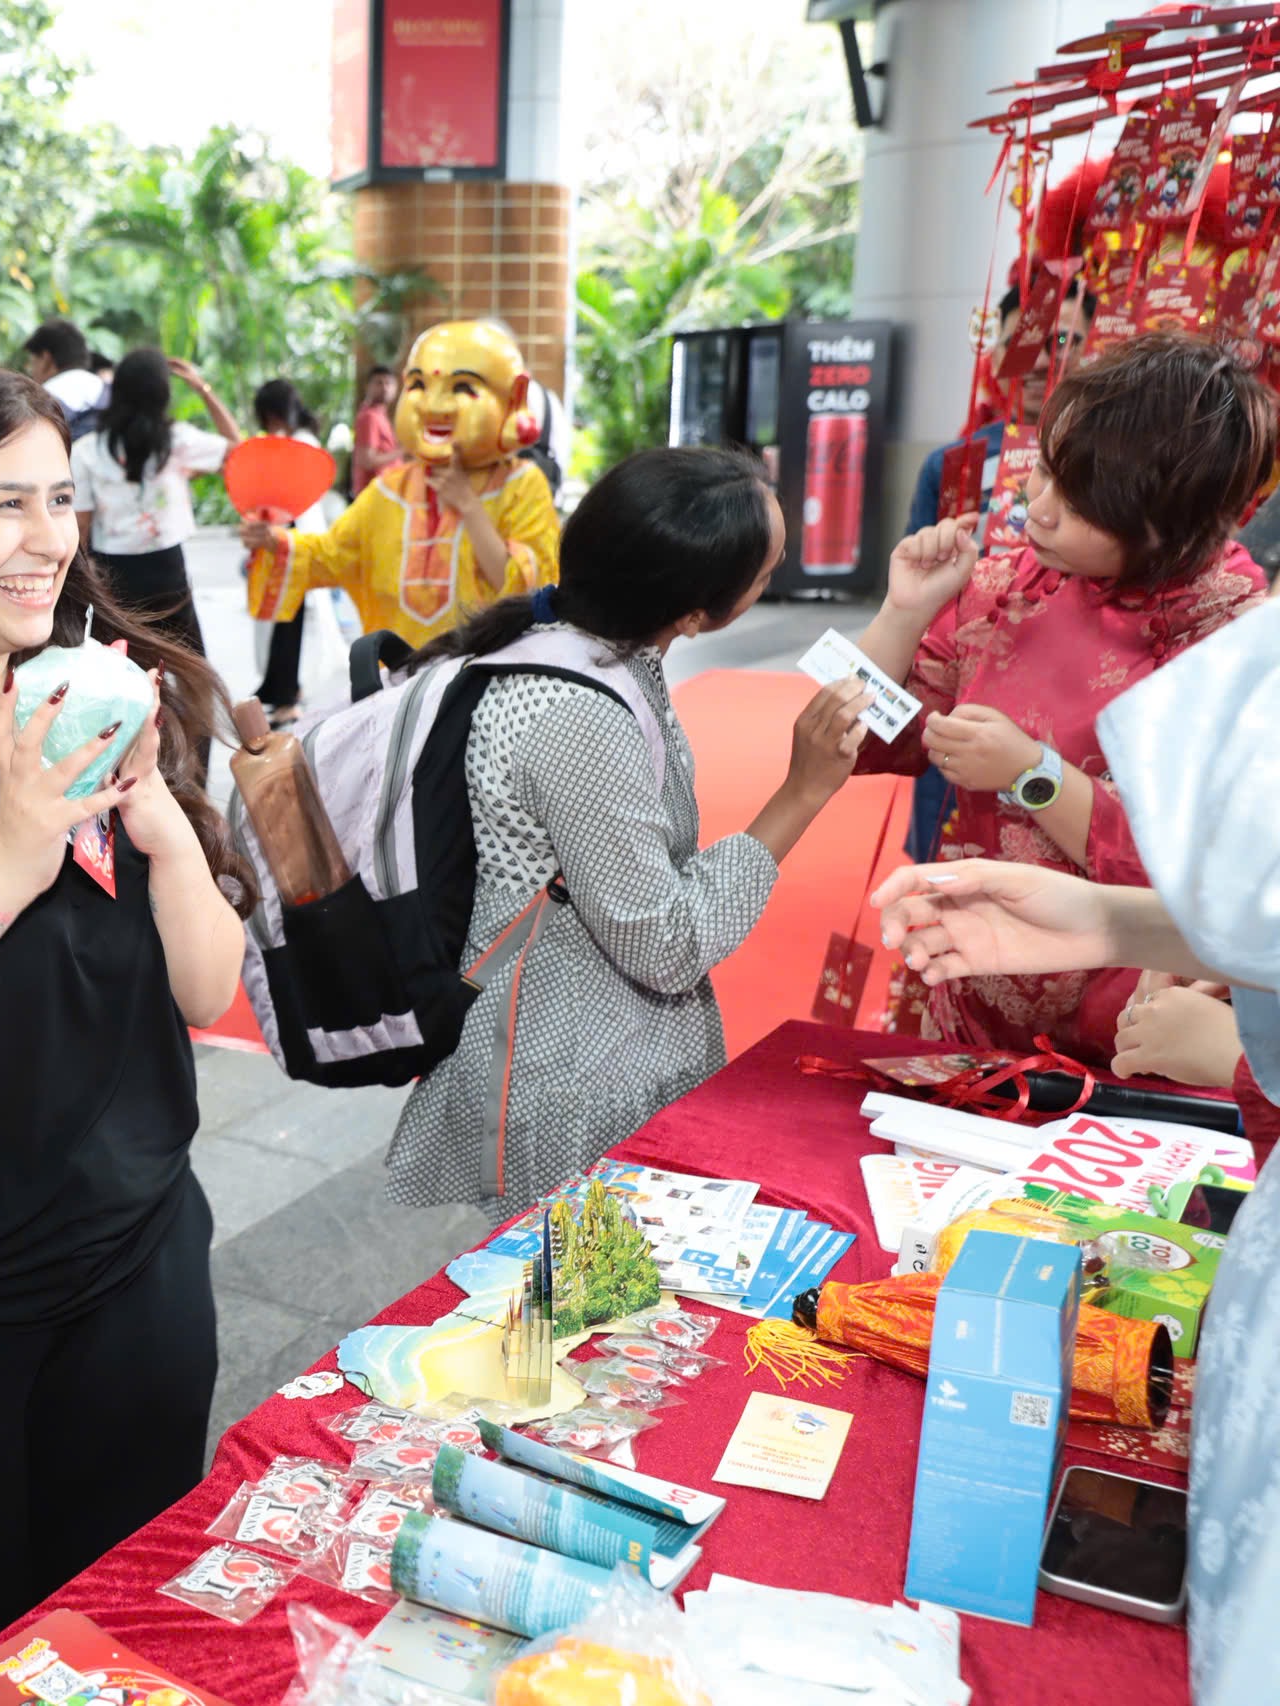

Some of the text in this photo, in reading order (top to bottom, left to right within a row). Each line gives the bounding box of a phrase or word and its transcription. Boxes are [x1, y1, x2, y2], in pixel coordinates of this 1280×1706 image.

[807, 335, 875, 362] THÊM
[808, 364, 872, 387] ZERO
[806, 388, 871, 412] CALO
